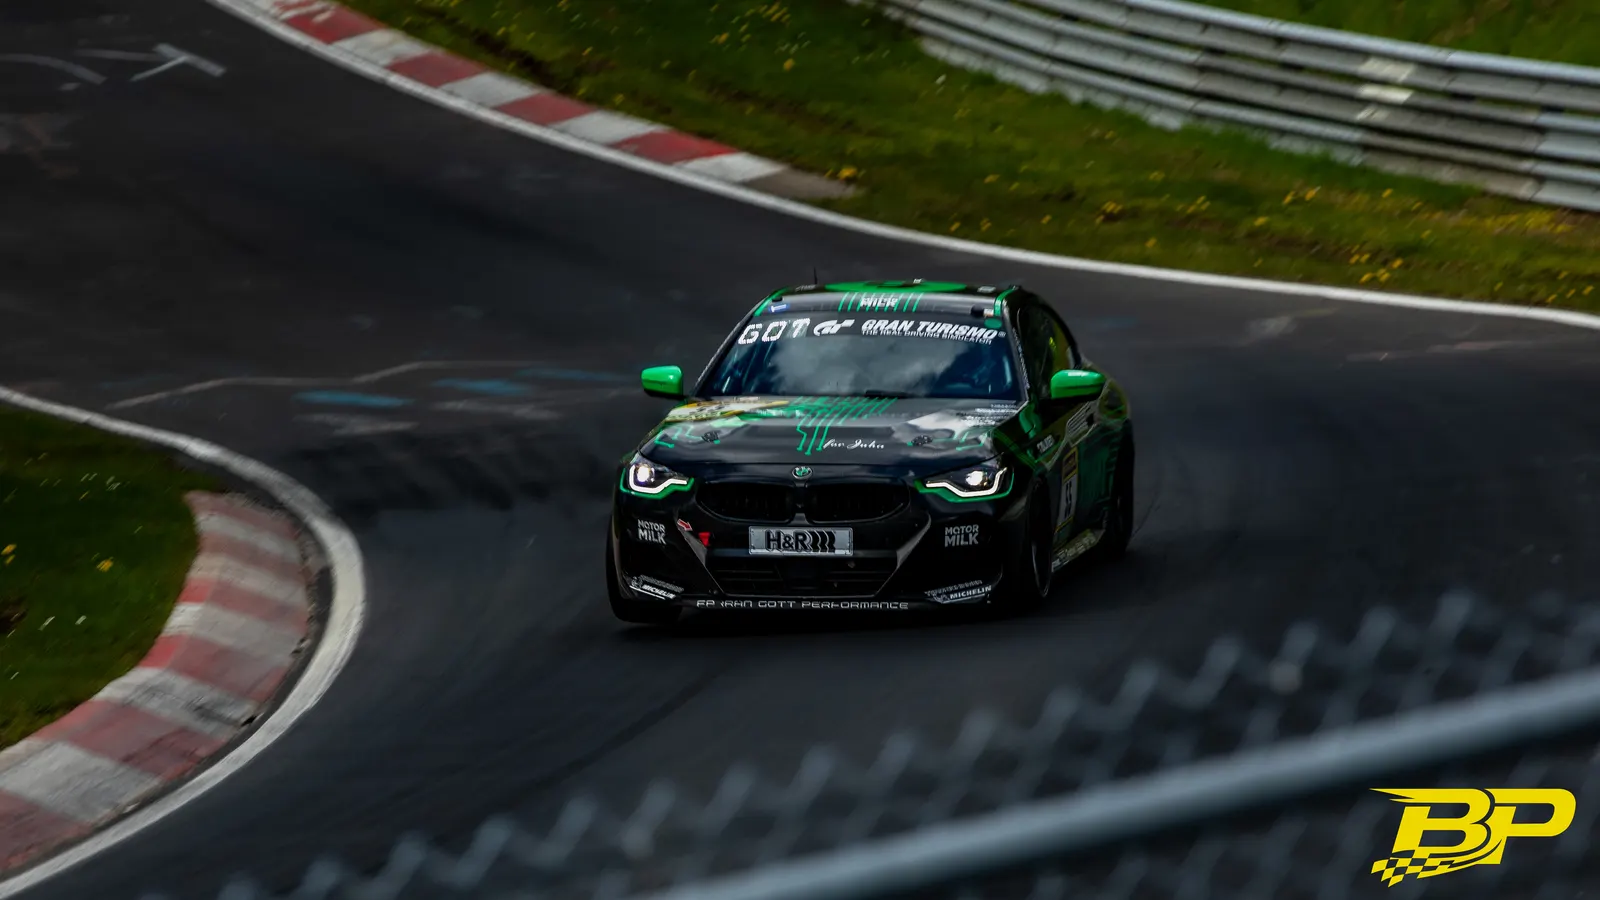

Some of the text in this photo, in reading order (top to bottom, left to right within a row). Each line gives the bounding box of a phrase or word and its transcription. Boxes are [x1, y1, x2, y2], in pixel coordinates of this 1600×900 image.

[861, 318, 998, 340] GRAN TURISMO
[879, 329, 902, 337] REAL
[904, 330, 940, 338] DRIVING
[941, 332, 993, 345] SIMULATOR
[637, 518, 666, 534] MOTOR
[944, 524, 980, 536] MOTOR
[637, 528, 667, 545] MILK
[765, 529, 814, 553] H&R
[944, 532, 979, 548] MILK
[949, 584, 992, 600] MICHELIN
[757, 600, 796, 609] GOTT
[801, 600, 909, 610] PERFORMANCE
